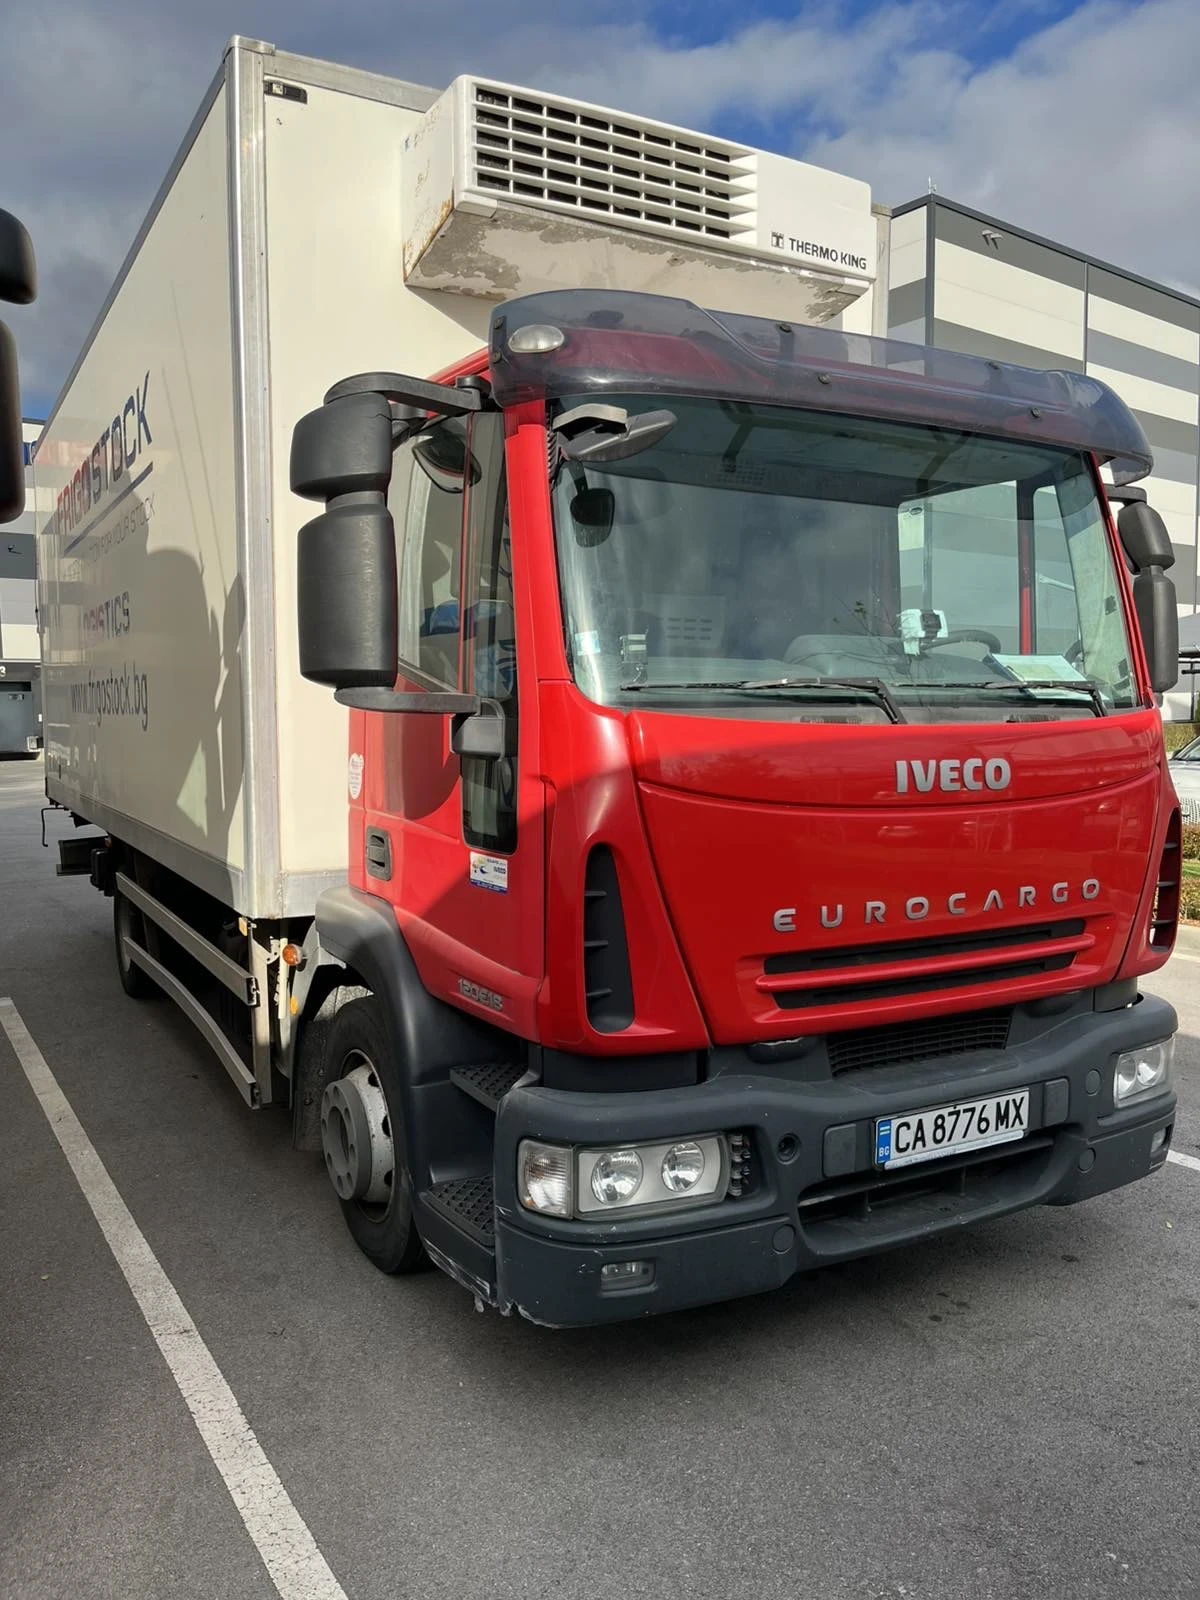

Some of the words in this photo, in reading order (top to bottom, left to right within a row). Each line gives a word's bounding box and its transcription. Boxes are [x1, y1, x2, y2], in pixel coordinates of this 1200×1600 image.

[789, 237, 838, 262] THERMO
[840, 252, 867, 270] KING
[57, 369, 152, 536] FRIGOSTOCK
[130, 490, 155, 534] STOCK
[80, 590, 130, 641] OGISTICS
[895, 758, 1011, 793] IVECO
[773, 878, 1100, 932] EUROCARGO
[895, 1118, 926, 1153] CA
[932, 1104, 990, 1144] 8776
[995, 1096, 1024, 1131] MX
[878, 1146, 890, 1157] BG
